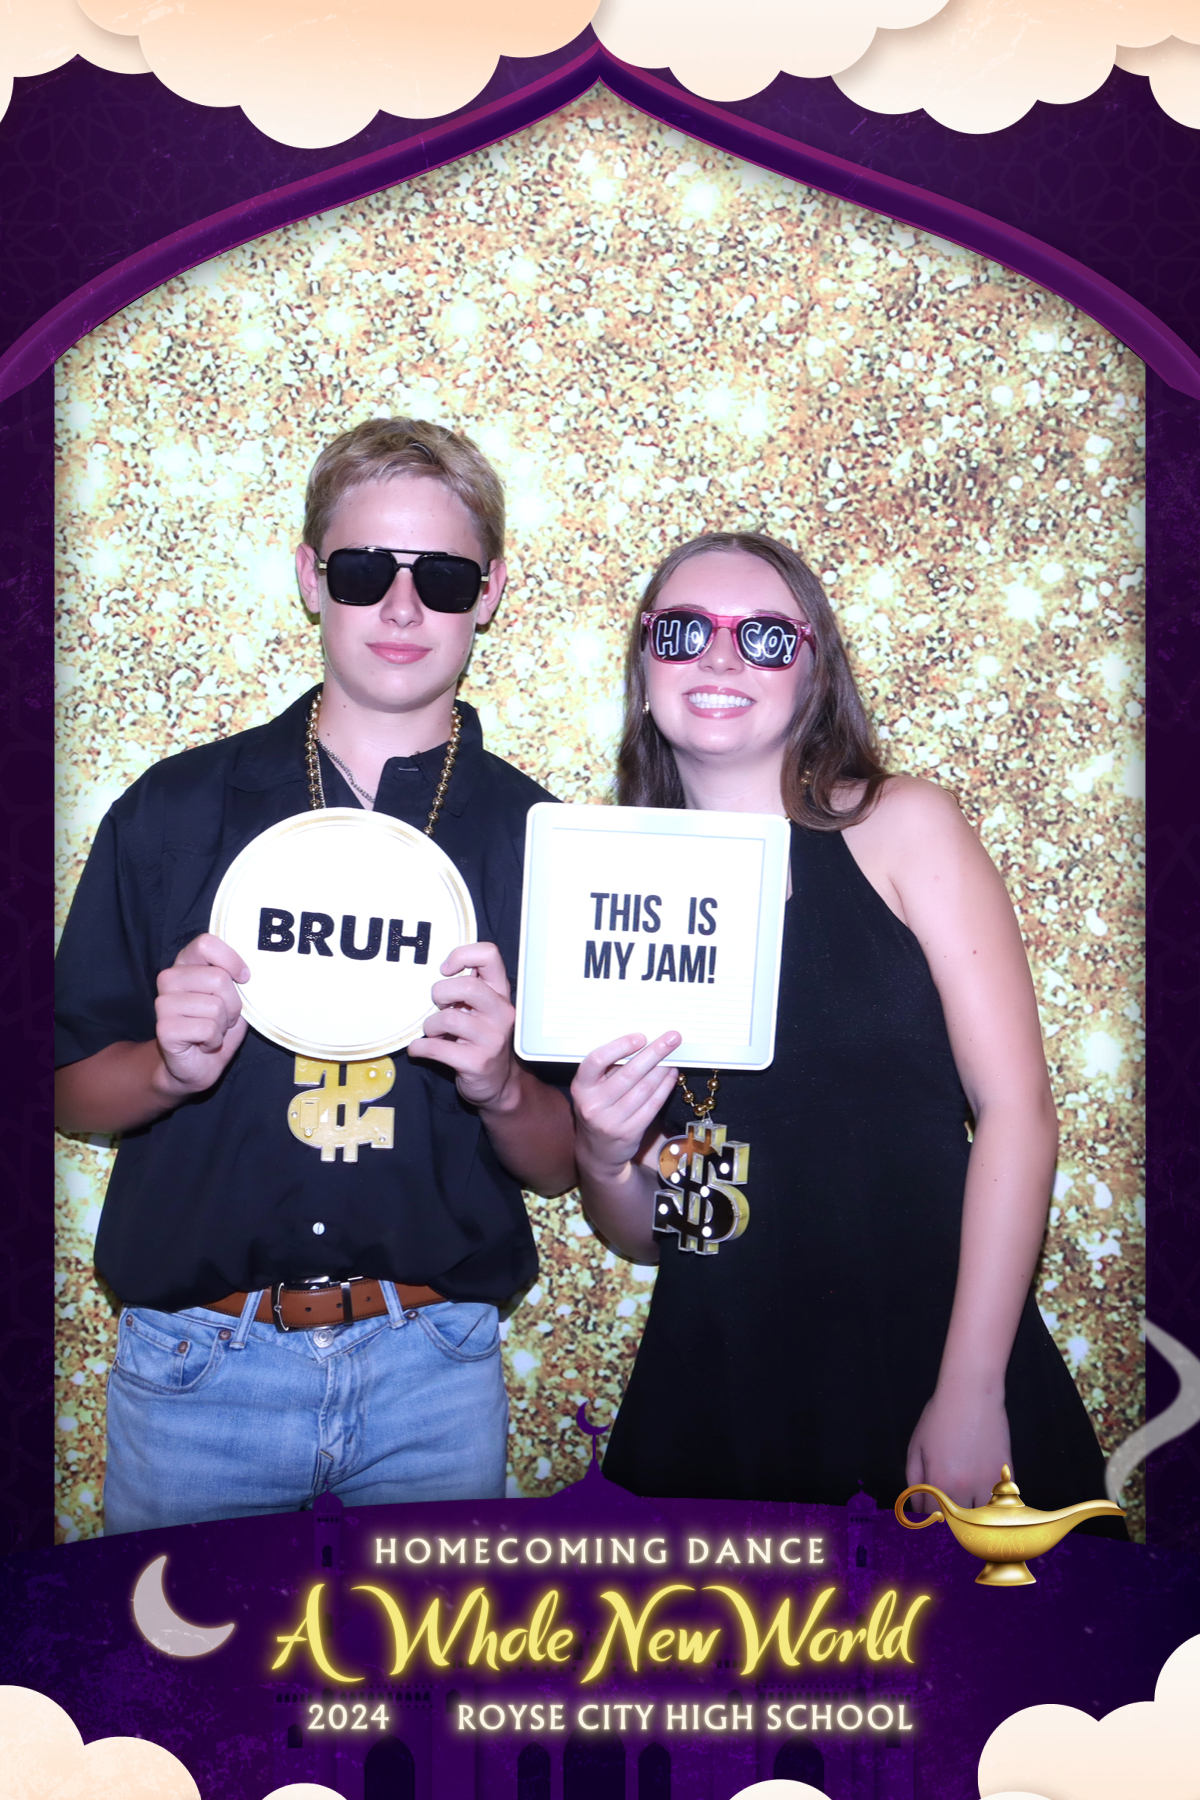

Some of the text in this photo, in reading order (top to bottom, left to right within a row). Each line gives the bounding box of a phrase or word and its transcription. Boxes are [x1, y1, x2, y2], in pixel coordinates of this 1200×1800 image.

[656, 620, 796, 664] HO CO!
[257, 907, 432, 965] BRUH
[590, 892, 718, 936] THIS IS
[584, 940, 717, 984] MY JAM!
